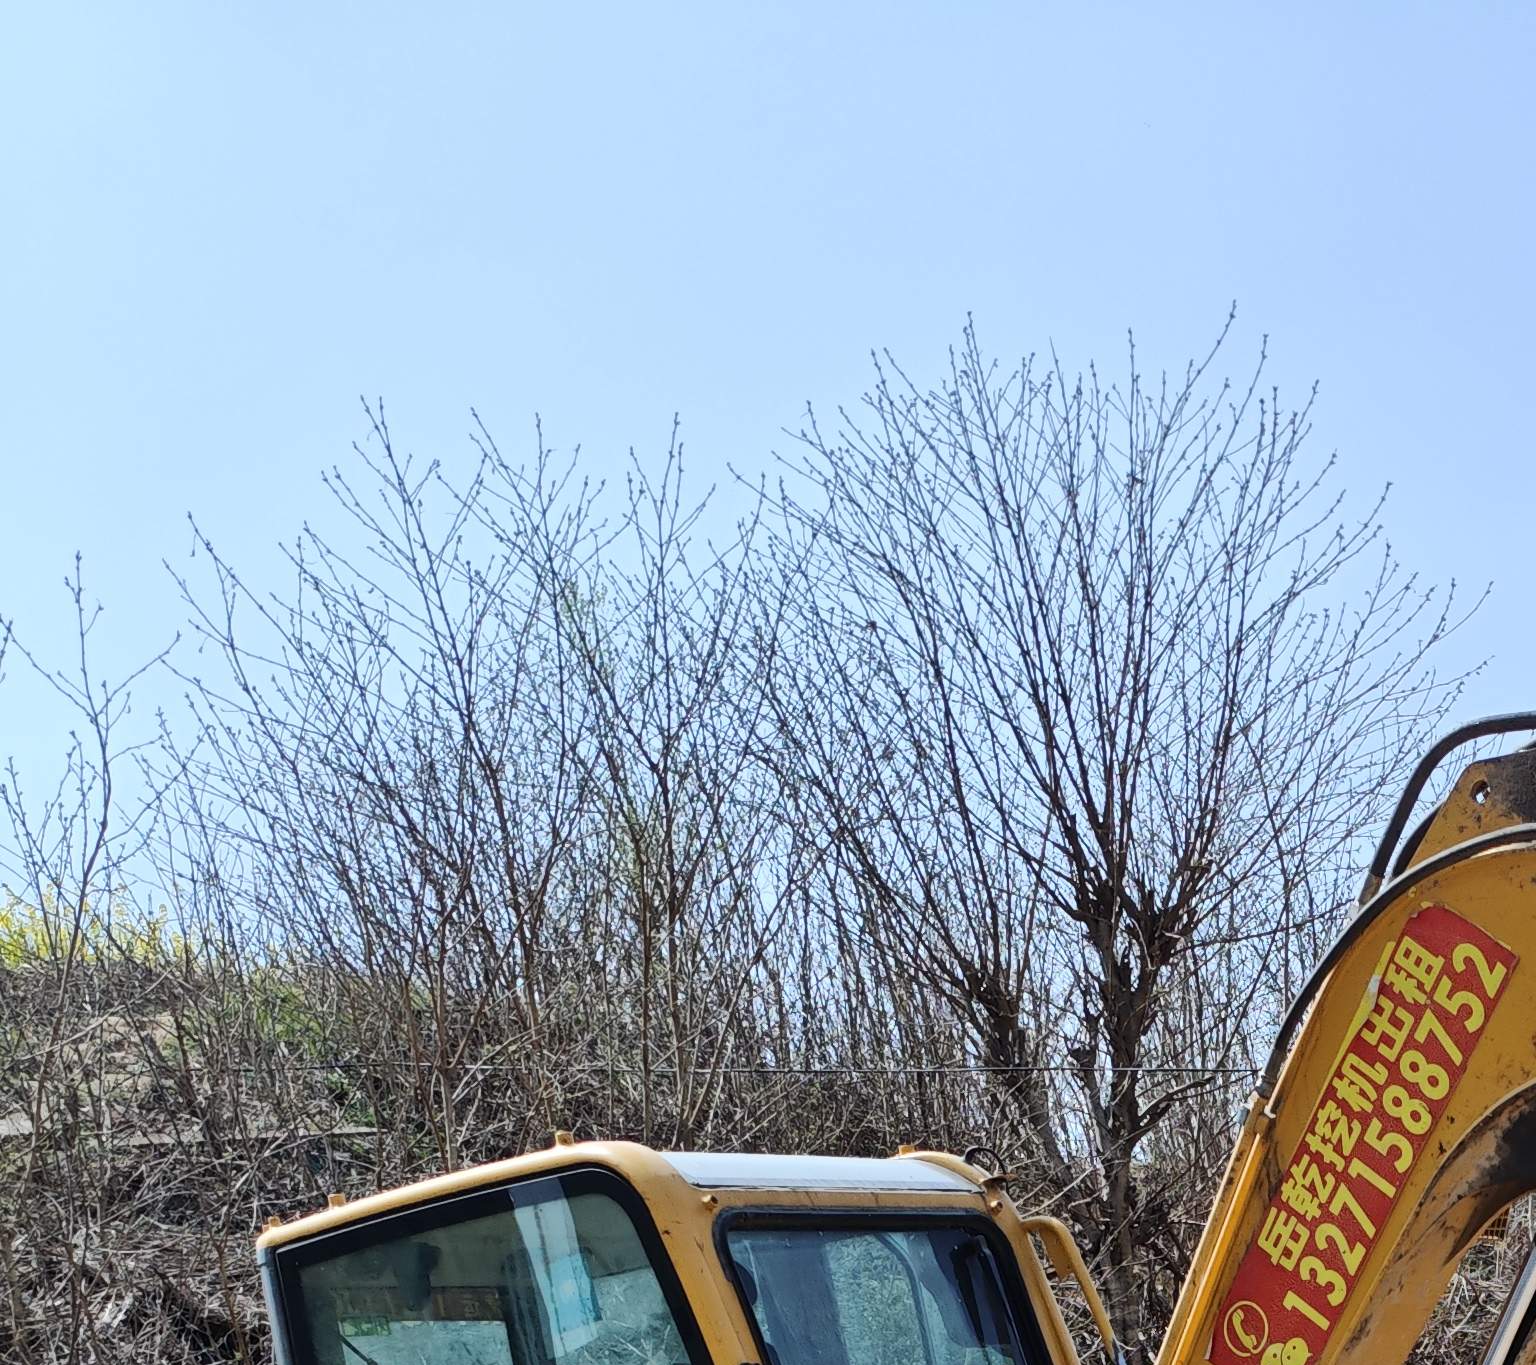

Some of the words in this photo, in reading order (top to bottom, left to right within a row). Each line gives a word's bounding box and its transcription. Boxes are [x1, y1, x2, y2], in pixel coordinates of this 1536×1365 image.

[1258, 936, 1445, 1272] 岳乾挖机出租
[1283, 942, 1507, 1331] 13271588752
